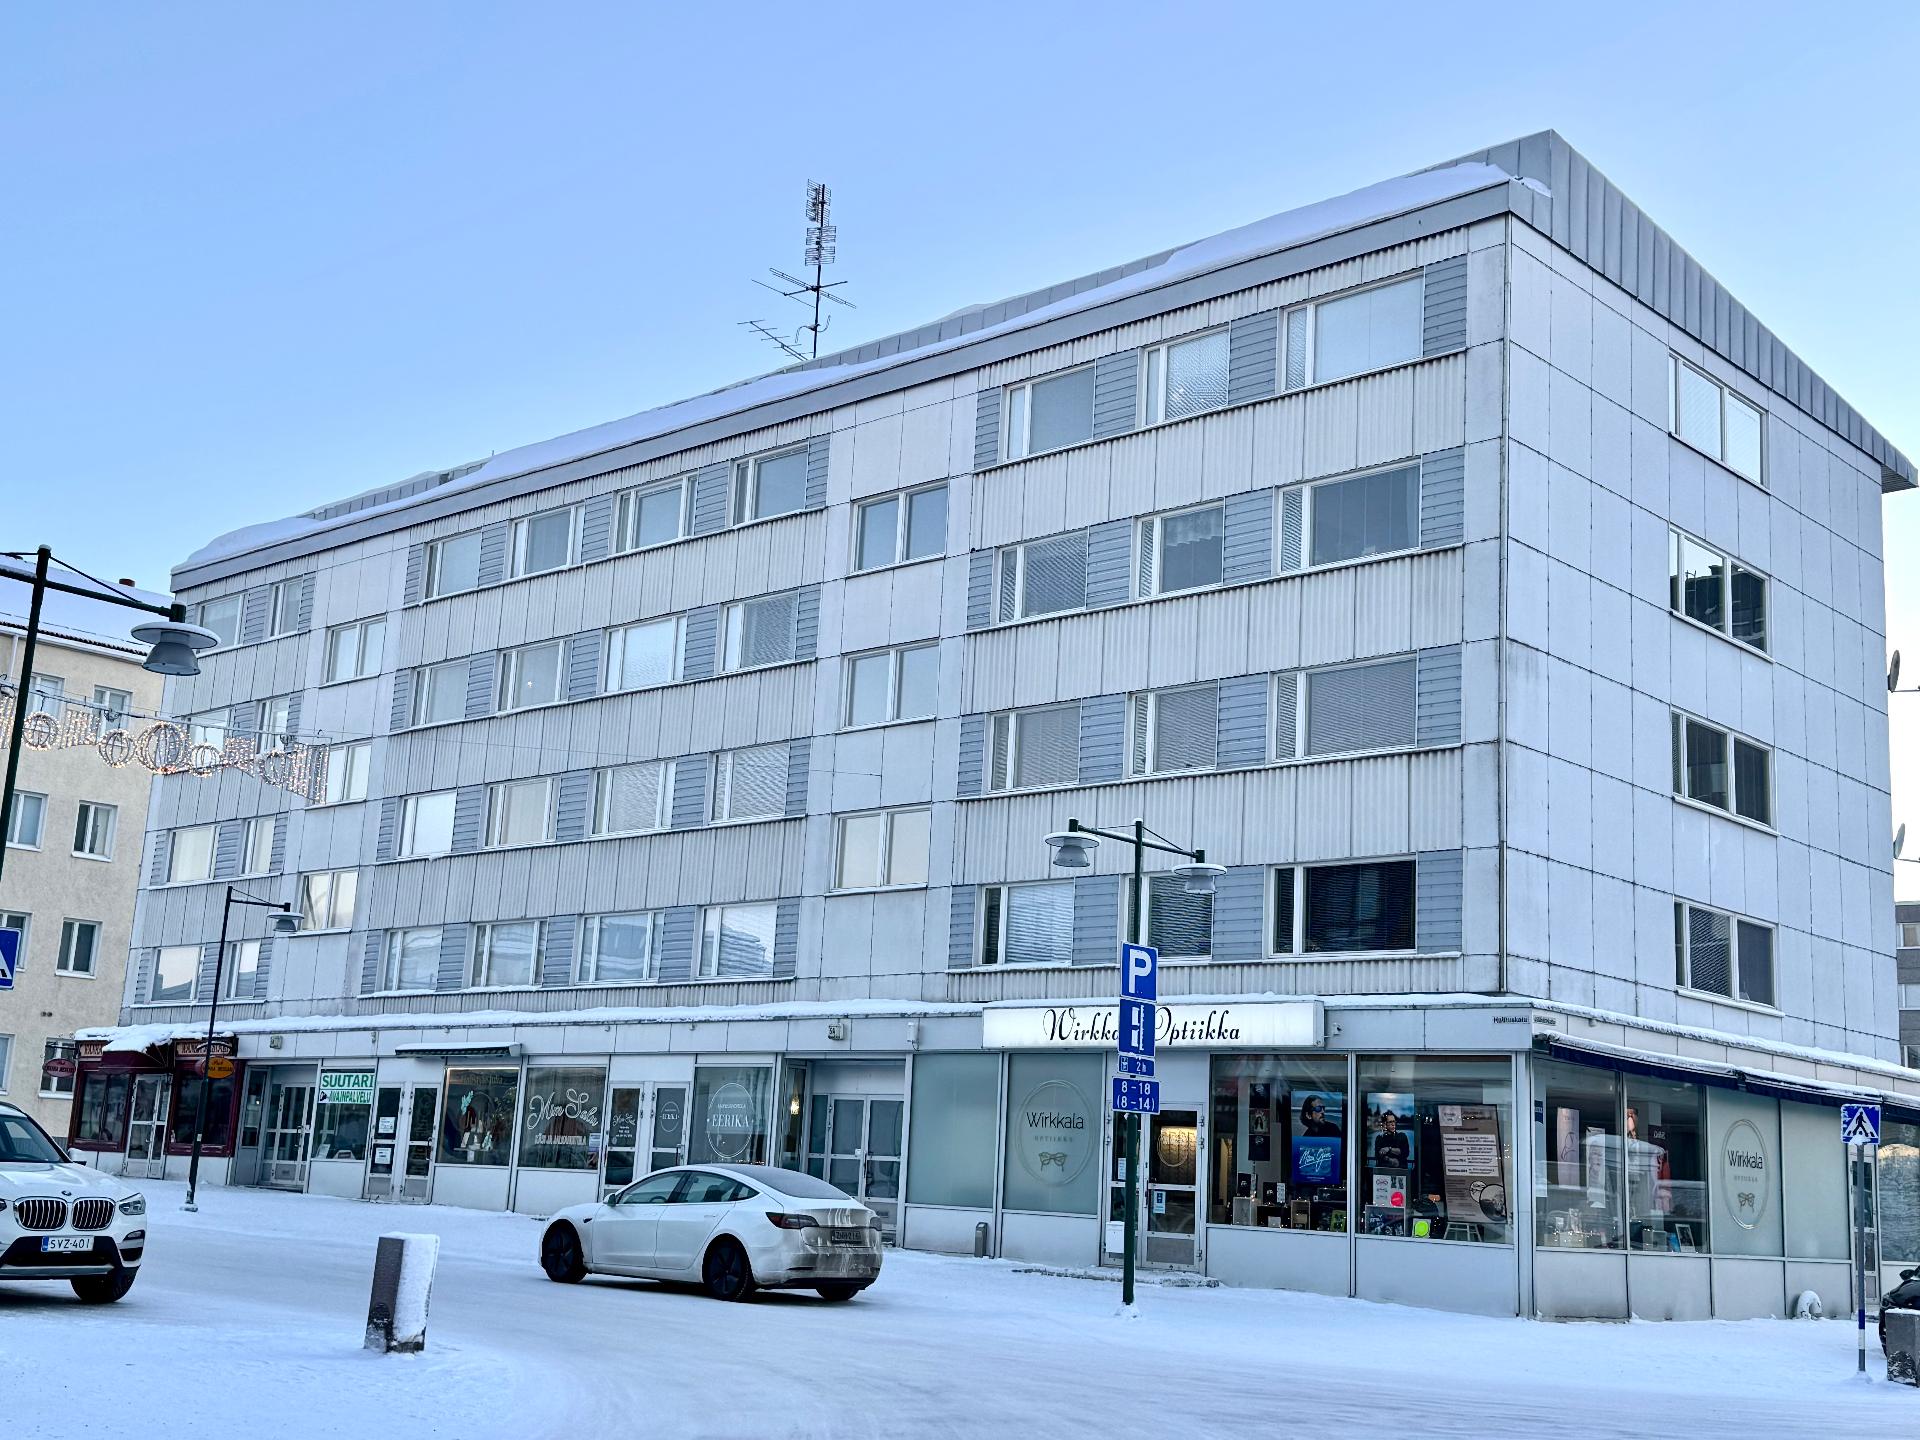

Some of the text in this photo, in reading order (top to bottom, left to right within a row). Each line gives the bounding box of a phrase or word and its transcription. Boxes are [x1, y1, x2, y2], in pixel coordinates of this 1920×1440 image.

[1129, 949, 1152, 993] P
[1043, 1007, 1241, 1046] Wirkka Optiikka
[322, 1074, 375, 1088] SUUTARI
[329, 1090, 372, 1103] AVAINPALVELU
[712, 1114, 749, 1127] EERIKA
[1026, 1112, 1084, 1129] Wirkkala
[1727, 1150, 1763, 1169] Wirkkala
[50, 1238, 90, 1249] SVZ-401
